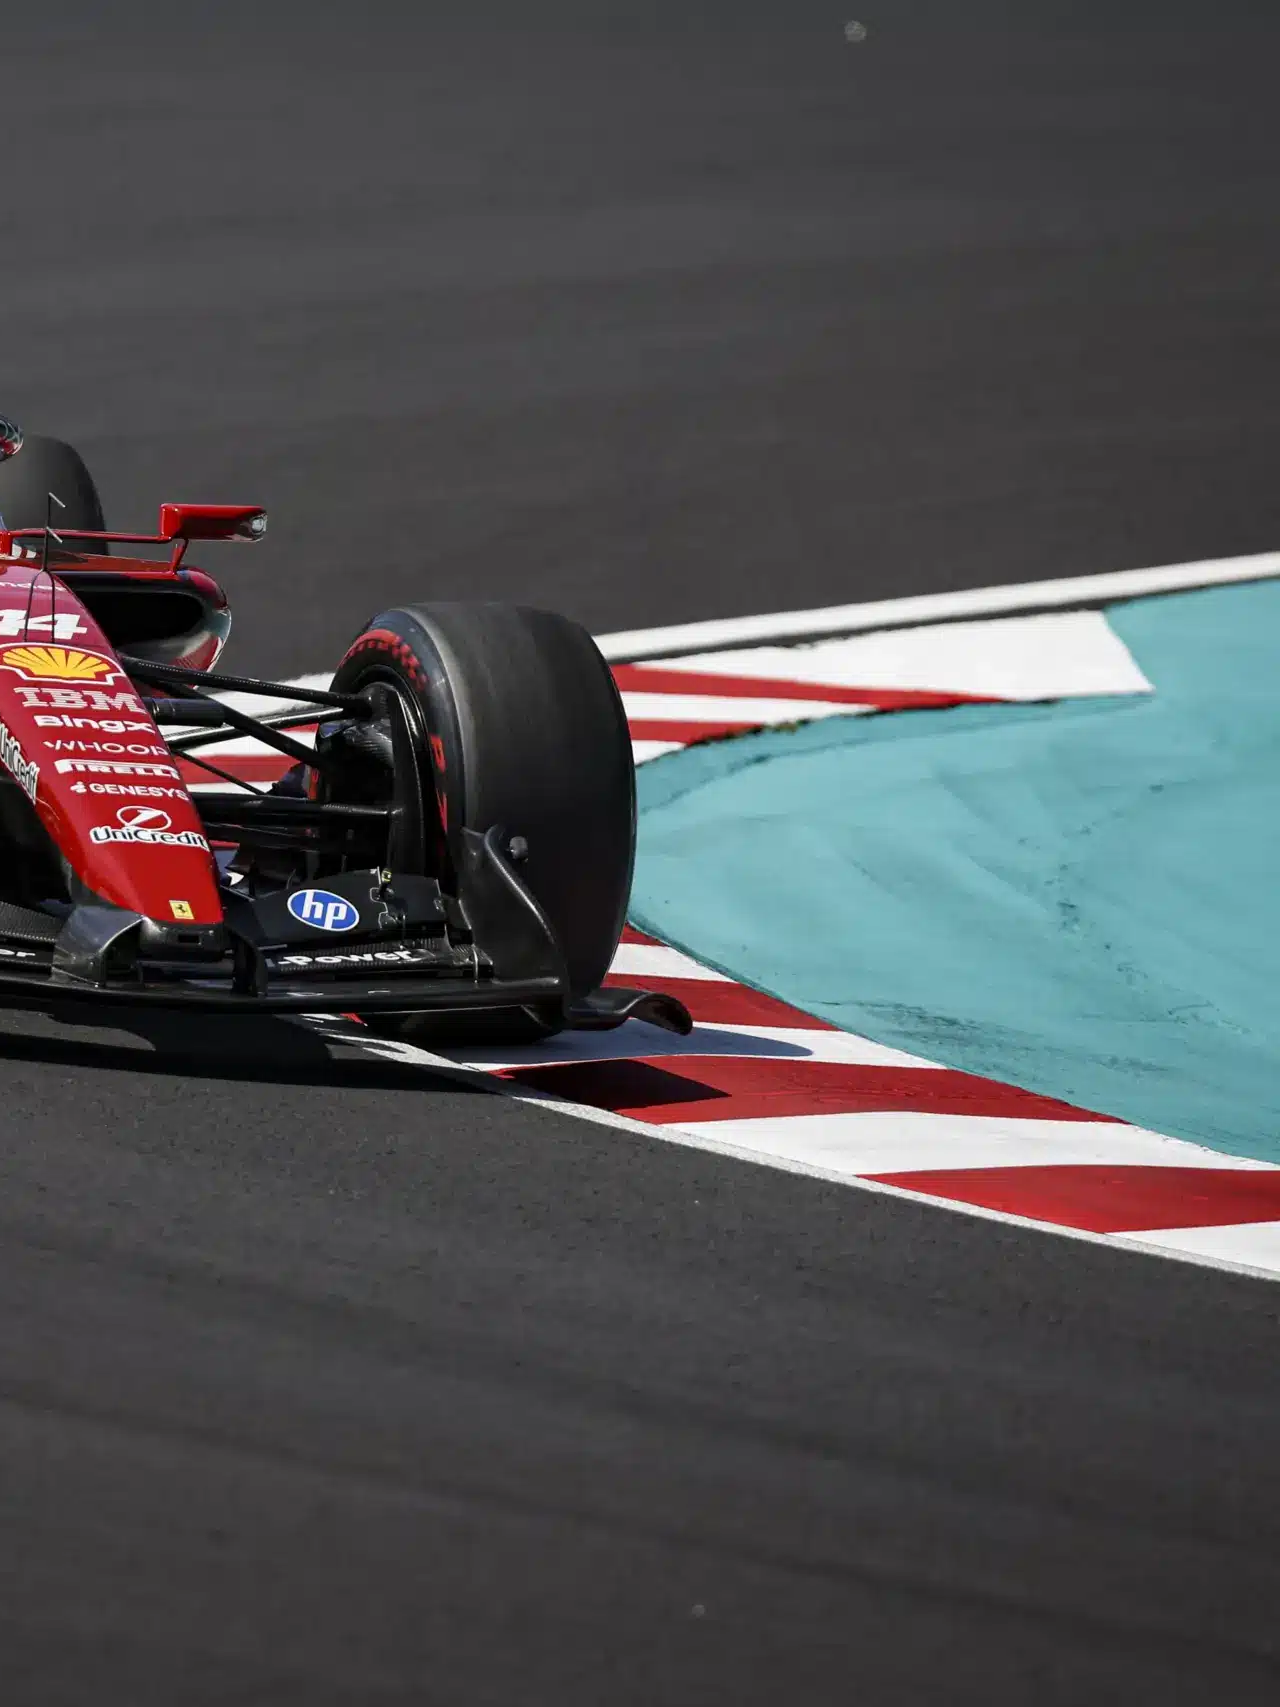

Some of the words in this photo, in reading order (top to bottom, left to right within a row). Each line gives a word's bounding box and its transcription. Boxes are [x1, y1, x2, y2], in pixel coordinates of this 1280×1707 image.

[13, 687, 147, 715] IBM
[33, 714, 156, 734] BingX
[42, 739, 169, 756] WHOOP
[54, 758, 181, 781] PIRELLI
[89, 782, 190, 801] GENESYS
[91, 827, 210, 851] UniCredit
[301, 889, 348, 930] hp
